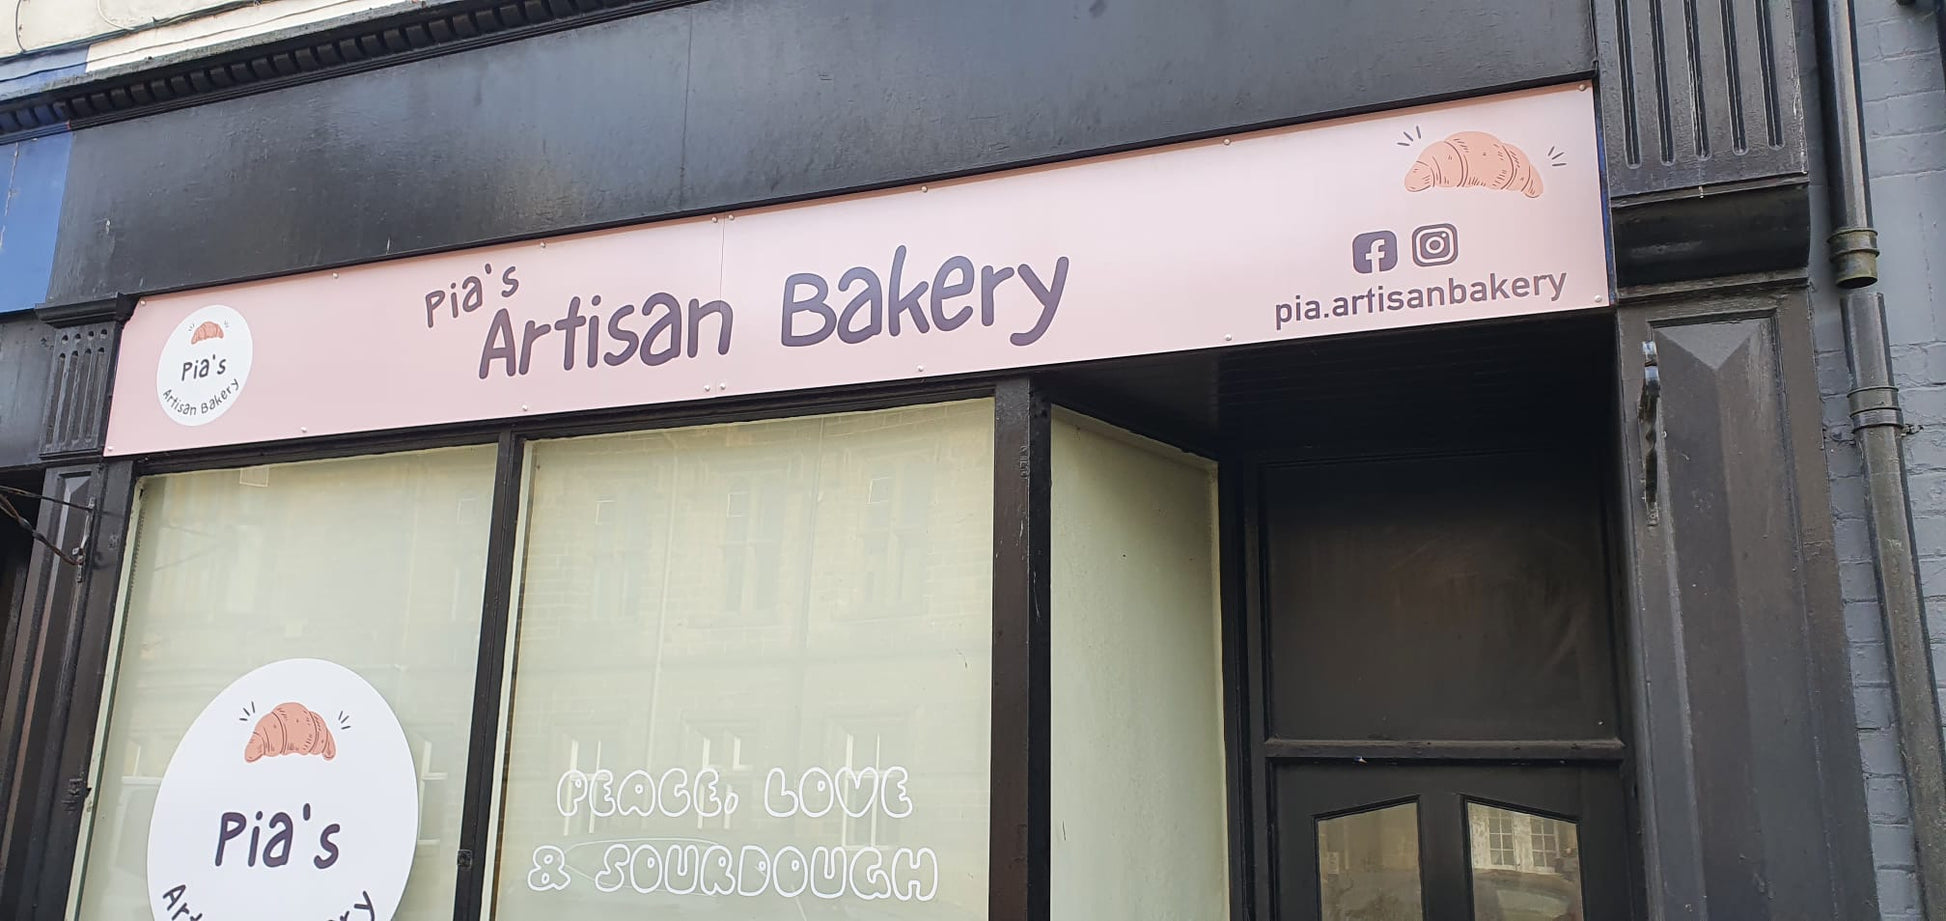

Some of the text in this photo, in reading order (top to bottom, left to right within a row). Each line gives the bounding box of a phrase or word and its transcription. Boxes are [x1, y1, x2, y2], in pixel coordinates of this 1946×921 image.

[425, 263, 519, 328] Pia's
[479, 244, 1069, 379] Artisan Bakery
[1275, 272, 1567, 330] pia.artisanbakery
[181, 353, 227, 381] Pia's
[163, 378, 240, 416] Artisan Bakery
[557, 766, 913, 818] PEACE, LOVE
[215, 803, 341, 869] Pia's
[527, 844, 938, 901] & SOURDOUGH
